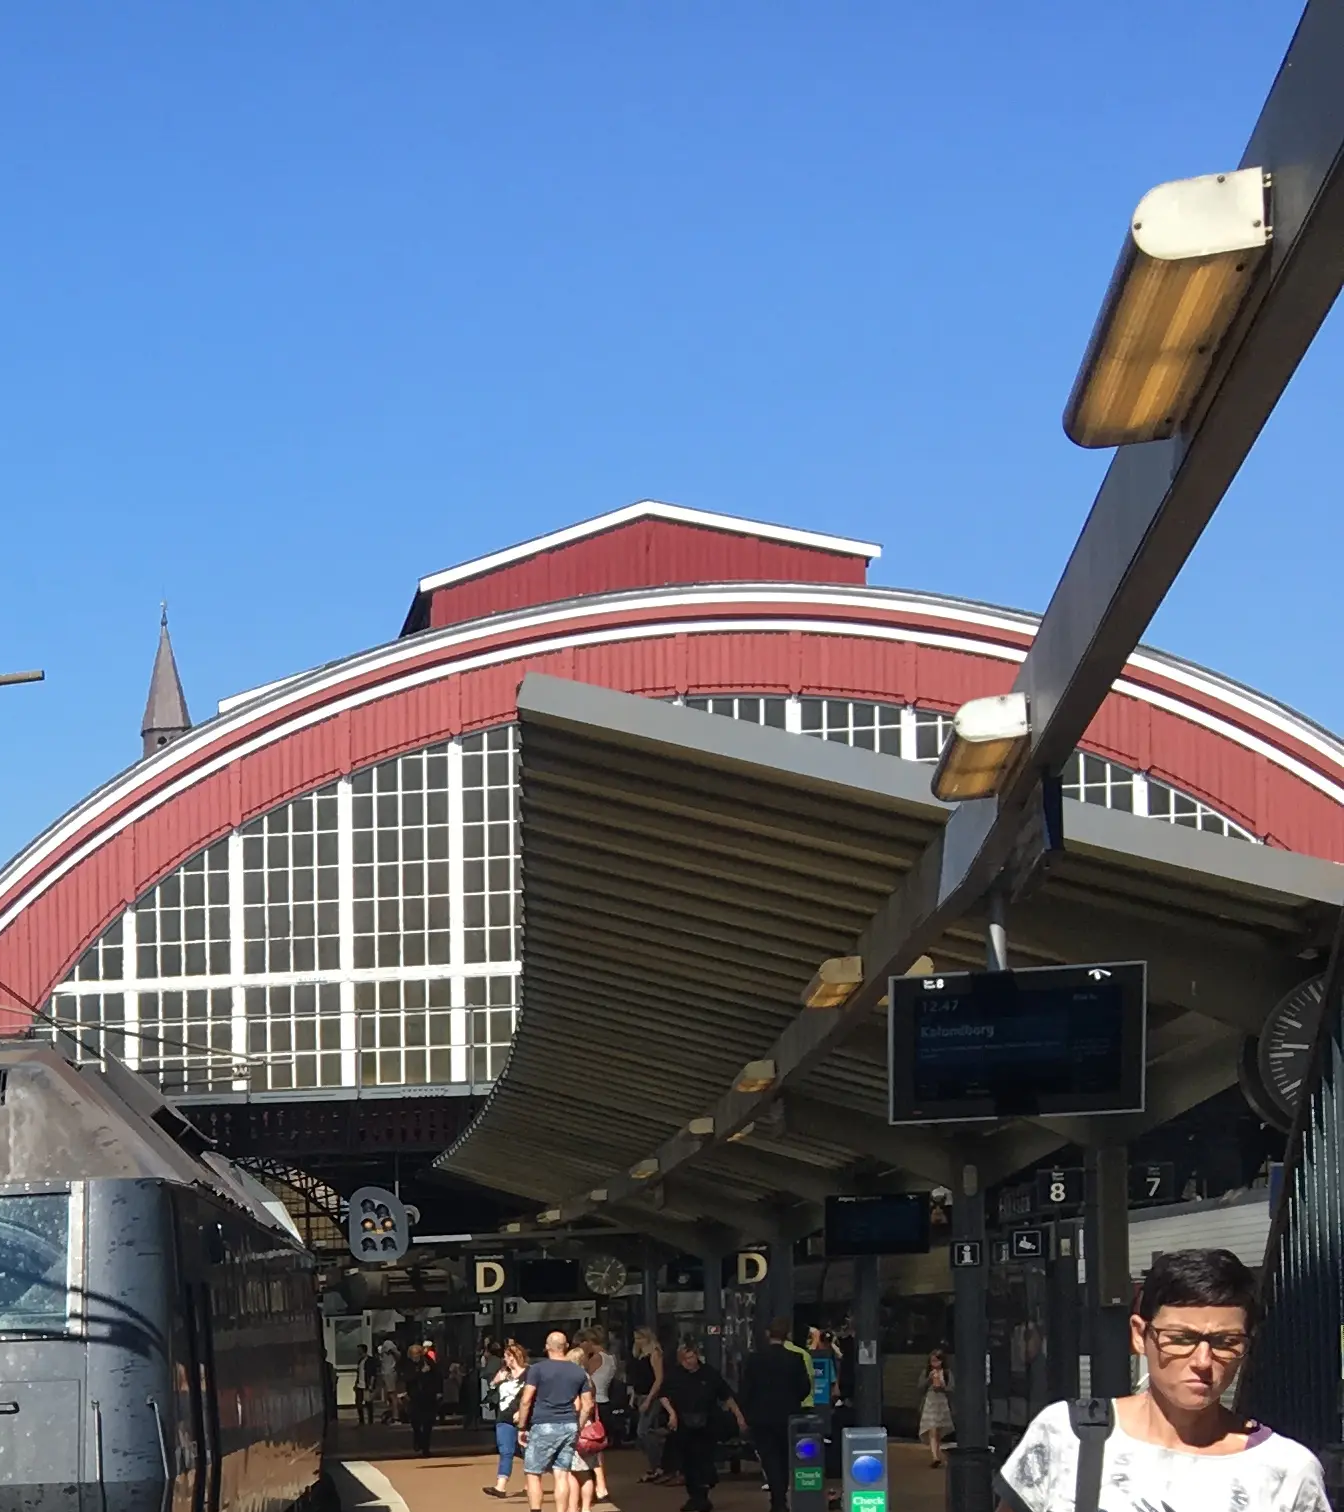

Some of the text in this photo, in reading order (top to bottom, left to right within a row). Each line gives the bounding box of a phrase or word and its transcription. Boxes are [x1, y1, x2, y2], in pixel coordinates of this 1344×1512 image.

[1050, 1182, 1066, 1202] 8
[1146, 1177, 1161, 1196] 7
[475, 1262, 505, 1293] D
[737, 1252, 768, 1285] D
[853, 1496, 885, 1505] Check
